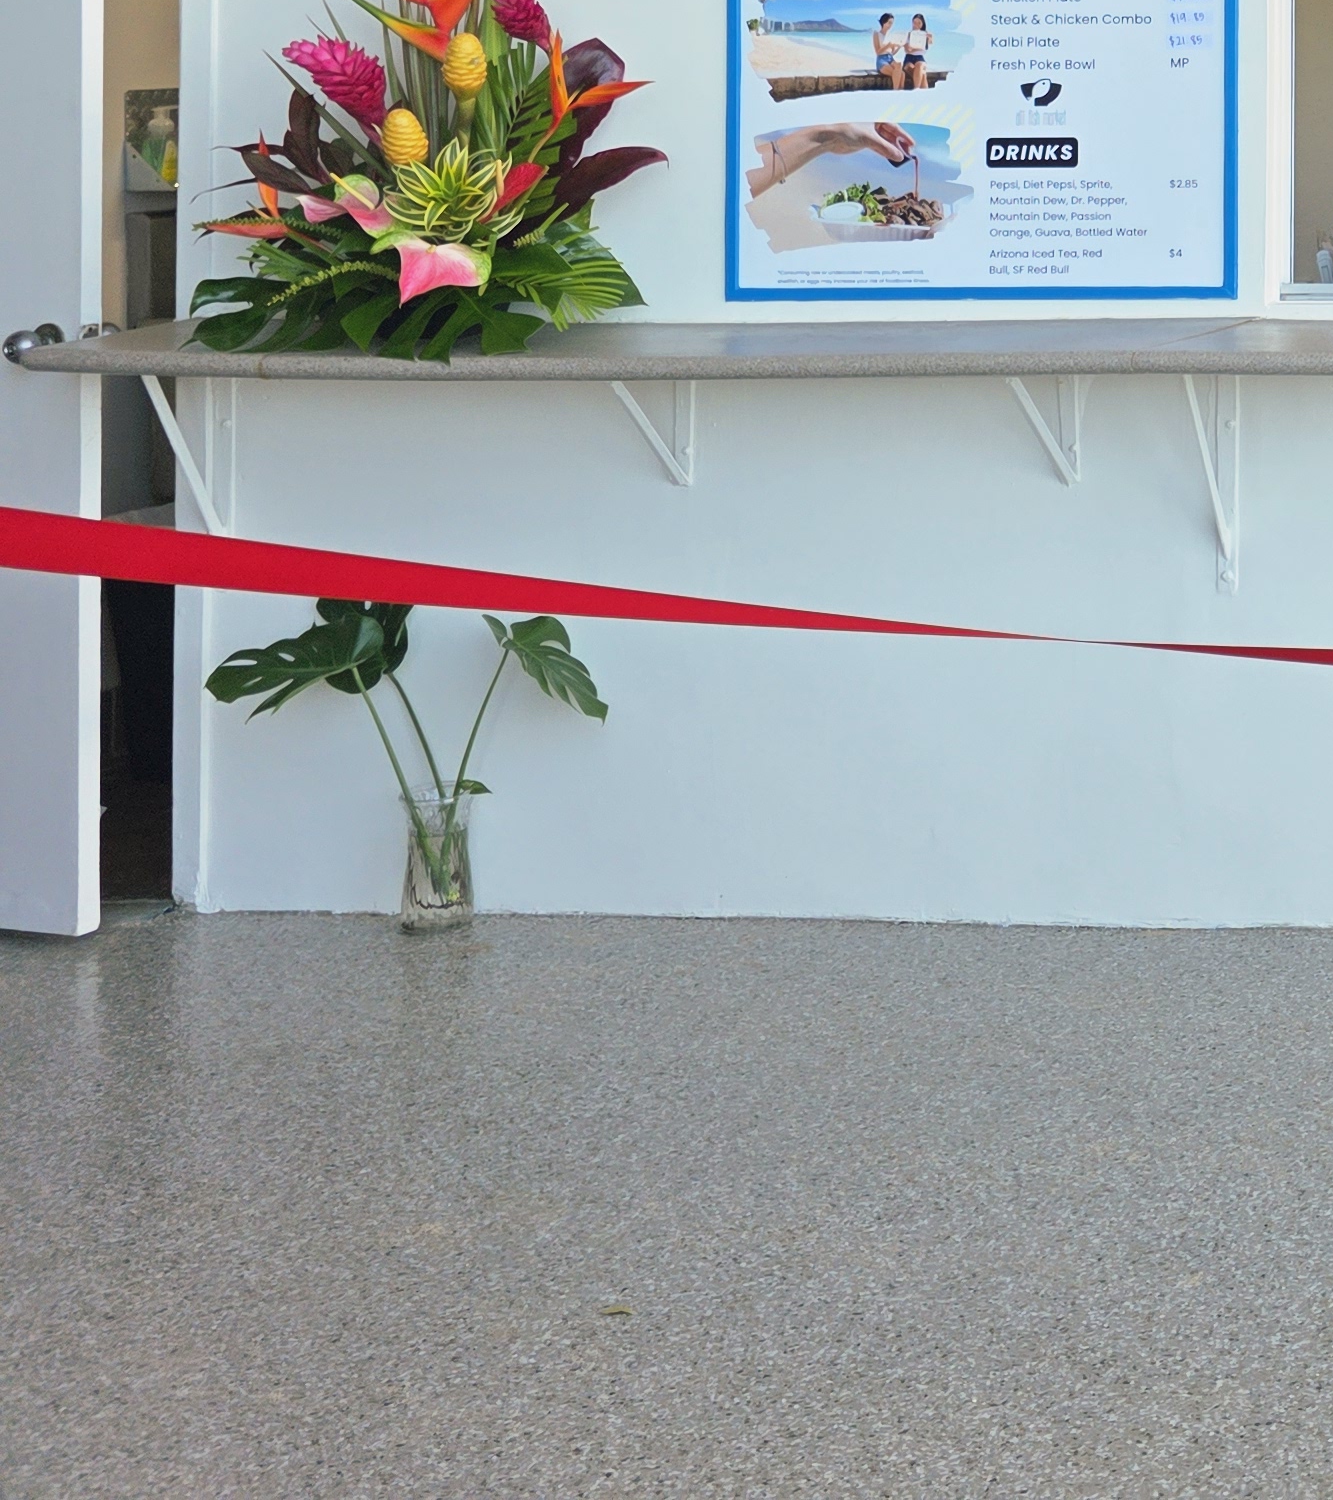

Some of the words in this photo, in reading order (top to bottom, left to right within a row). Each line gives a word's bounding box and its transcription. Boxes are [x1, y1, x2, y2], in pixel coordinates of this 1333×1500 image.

[991, 14, 1027, 25] Steak
[1031, 15, 1040, 25] &
[1044, 14, 1098, 25] Chicken
[1102, 14, 1152, 25] Combo
[991, 37, 1023, 48] Kalbi
[1027, 37, 1060, 47] Plate
[990, 59, 1026, 70] Fresh
[1029, 59, 1060, 70] Poke
[1065, 59, 1095, 70] Bowl
[1170, 58, 1189, 68] MP
[990, 145, 1073, 161] DRINKS
[990, 180, 1020, 191] Pepsi,
[1023, 180, 1044, 189] Diet
[1047, 180, 1077, 191] Pepsi,
[1080, 180, 1113, 191] Sprite,
[1169, 180, 1198, 188] $2.85
[990, 196, 1040, 206] Mountain
[1043, 196, 1068, 207] Dew,
[1071, 196, 1085, 205] Dr.
[1088, 196, 1127, 207] Pepper,
[990, 212, 1040, 221] Mountain
[1043, 212, 1068, 223] Dew,
[1071, 212, 1111, 221] Passion
[990, 228, 1032, 240] Orange,
[1035, 228, 1072, 238] Guava,
[1076, 228, 1113, 237] Bottled
[1116, 228, 1147, 237] Water
[990, 249, 1029, 259] Arizona
[1032, 249, 1054, 258] Iced
[1058, 249, 1080, 259] Tea,
[1083, 249, 1102, 258] Red
[1169, 249, 1182, 258] $4
[990, 266, 1010, 275] Bull,
[1013, 266, 1025, 274] SF
[1028, 266, 1048, 274] Red
[1051, 265, 1069, 274] Bull
